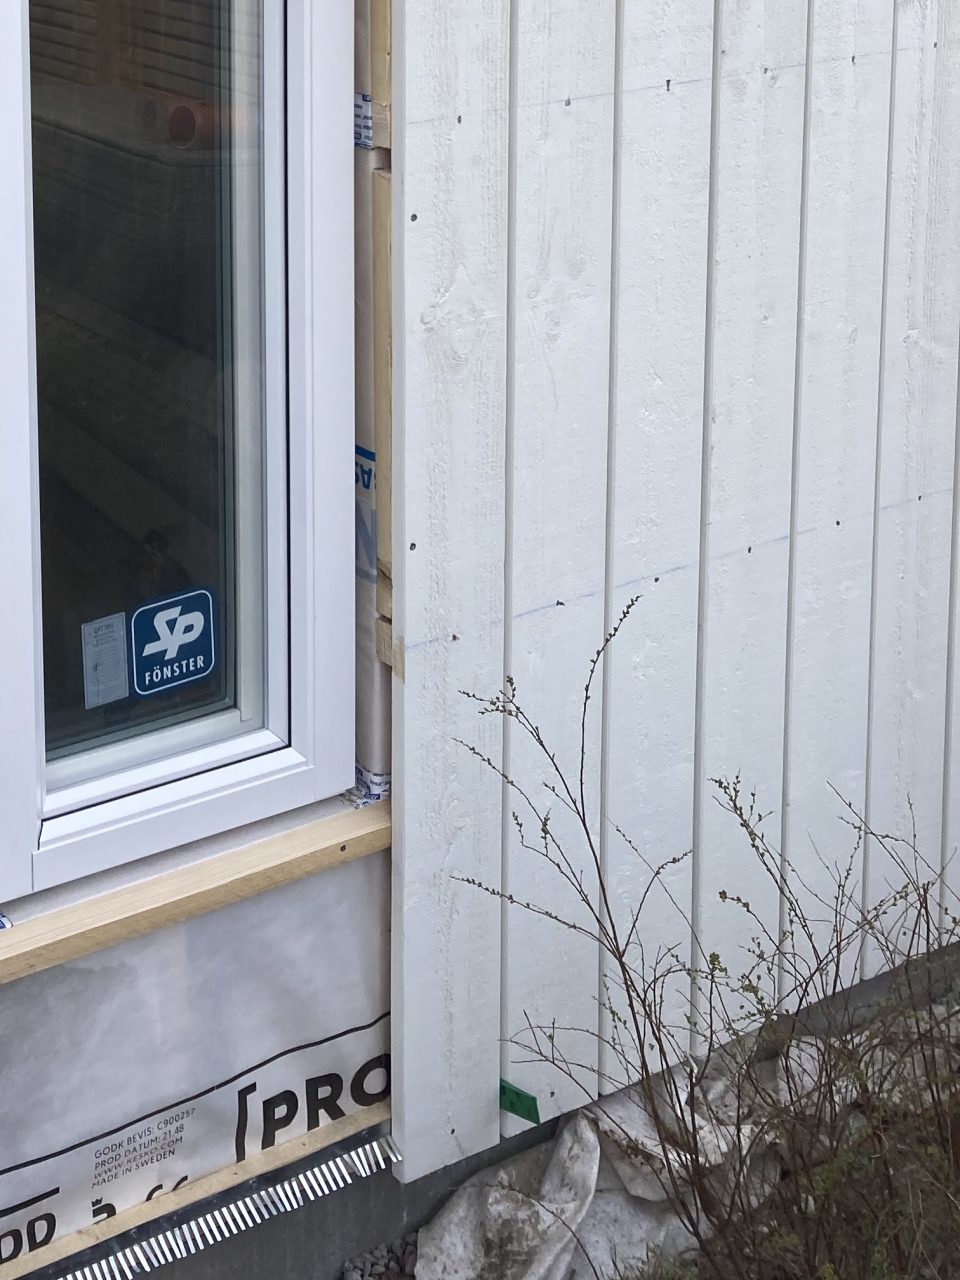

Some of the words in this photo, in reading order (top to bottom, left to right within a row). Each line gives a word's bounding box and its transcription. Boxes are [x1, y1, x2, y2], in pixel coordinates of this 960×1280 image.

[145, 655, 204, 685] FÖNSTER
[94, 1140, 124, 1159] GODK
[127, 1126, 155, 1146] BEVIS:
[157, 1107, 196, 1131] C900257
[92, 1172, 119, 1189] MADE
[122, 1167, 132, 1176] IN
[135, 1148, 176, 1170] SWEDEN
[94, 1153, 121, 1171] PROD
[124, 1136, 161, 1158] DATUM:
